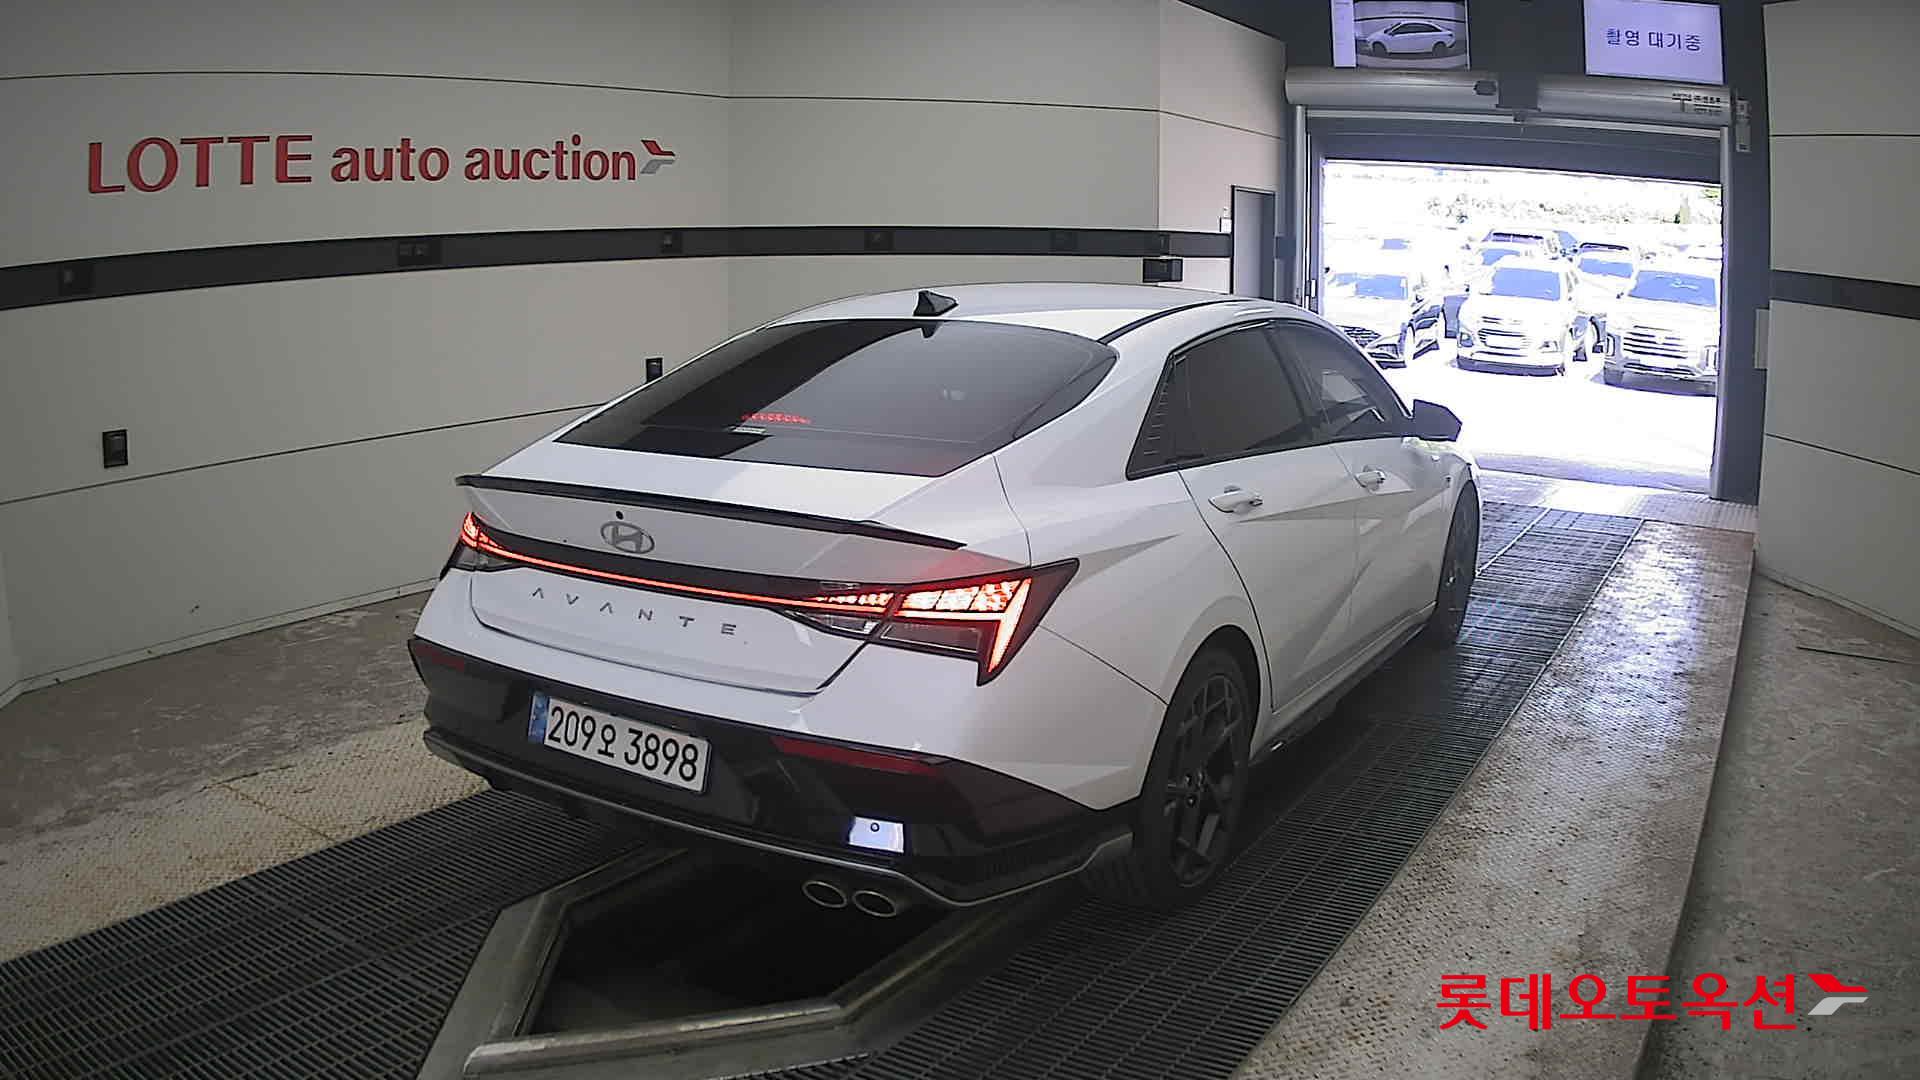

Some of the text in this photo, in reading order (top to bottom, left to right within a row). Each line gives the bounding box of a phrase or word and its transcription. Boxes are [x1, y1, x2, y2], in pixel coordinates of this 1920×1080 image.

[1648, 31, 1702, 51] 대기중
[88, 134, 637, 194] LOTTE auto auction
[532, 587, 737, 636] AVANTE
[624, 727, 698, 782] 3898
